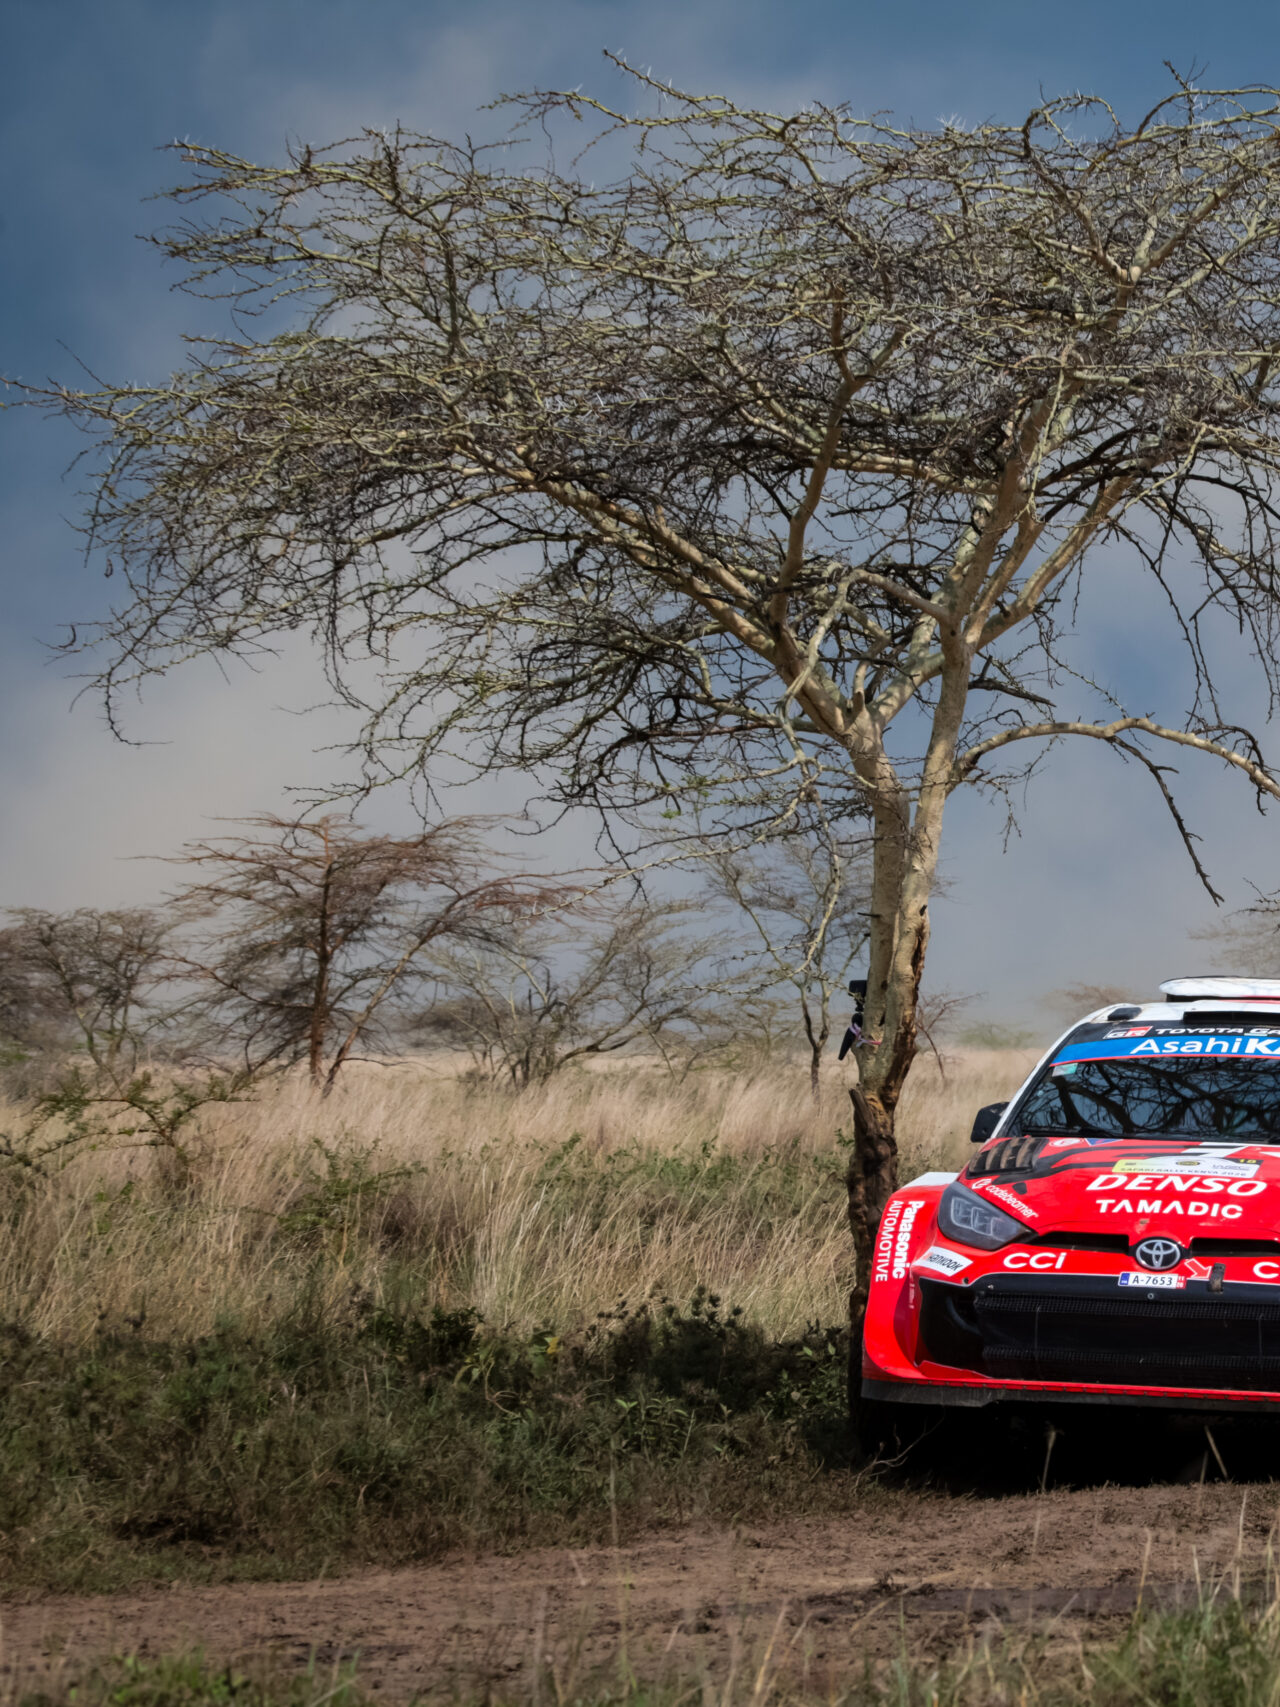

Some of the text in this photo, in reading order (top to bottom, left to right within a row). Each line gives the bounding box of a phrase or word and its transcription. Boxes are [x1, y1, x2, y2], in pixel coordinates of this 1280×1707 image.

[1085, 1174, 1268, 1196] DENSO
[985, 1184, 1039, 1218] codebeamer
[1096, 1199, 1244, 1219] TAMADIC
[875, 1200, 905, 1282] AUTOMOTIVE
[892, 1200, 926, 1279] Panasonic
[1132, 1275, 1173, 1286] A-7653
